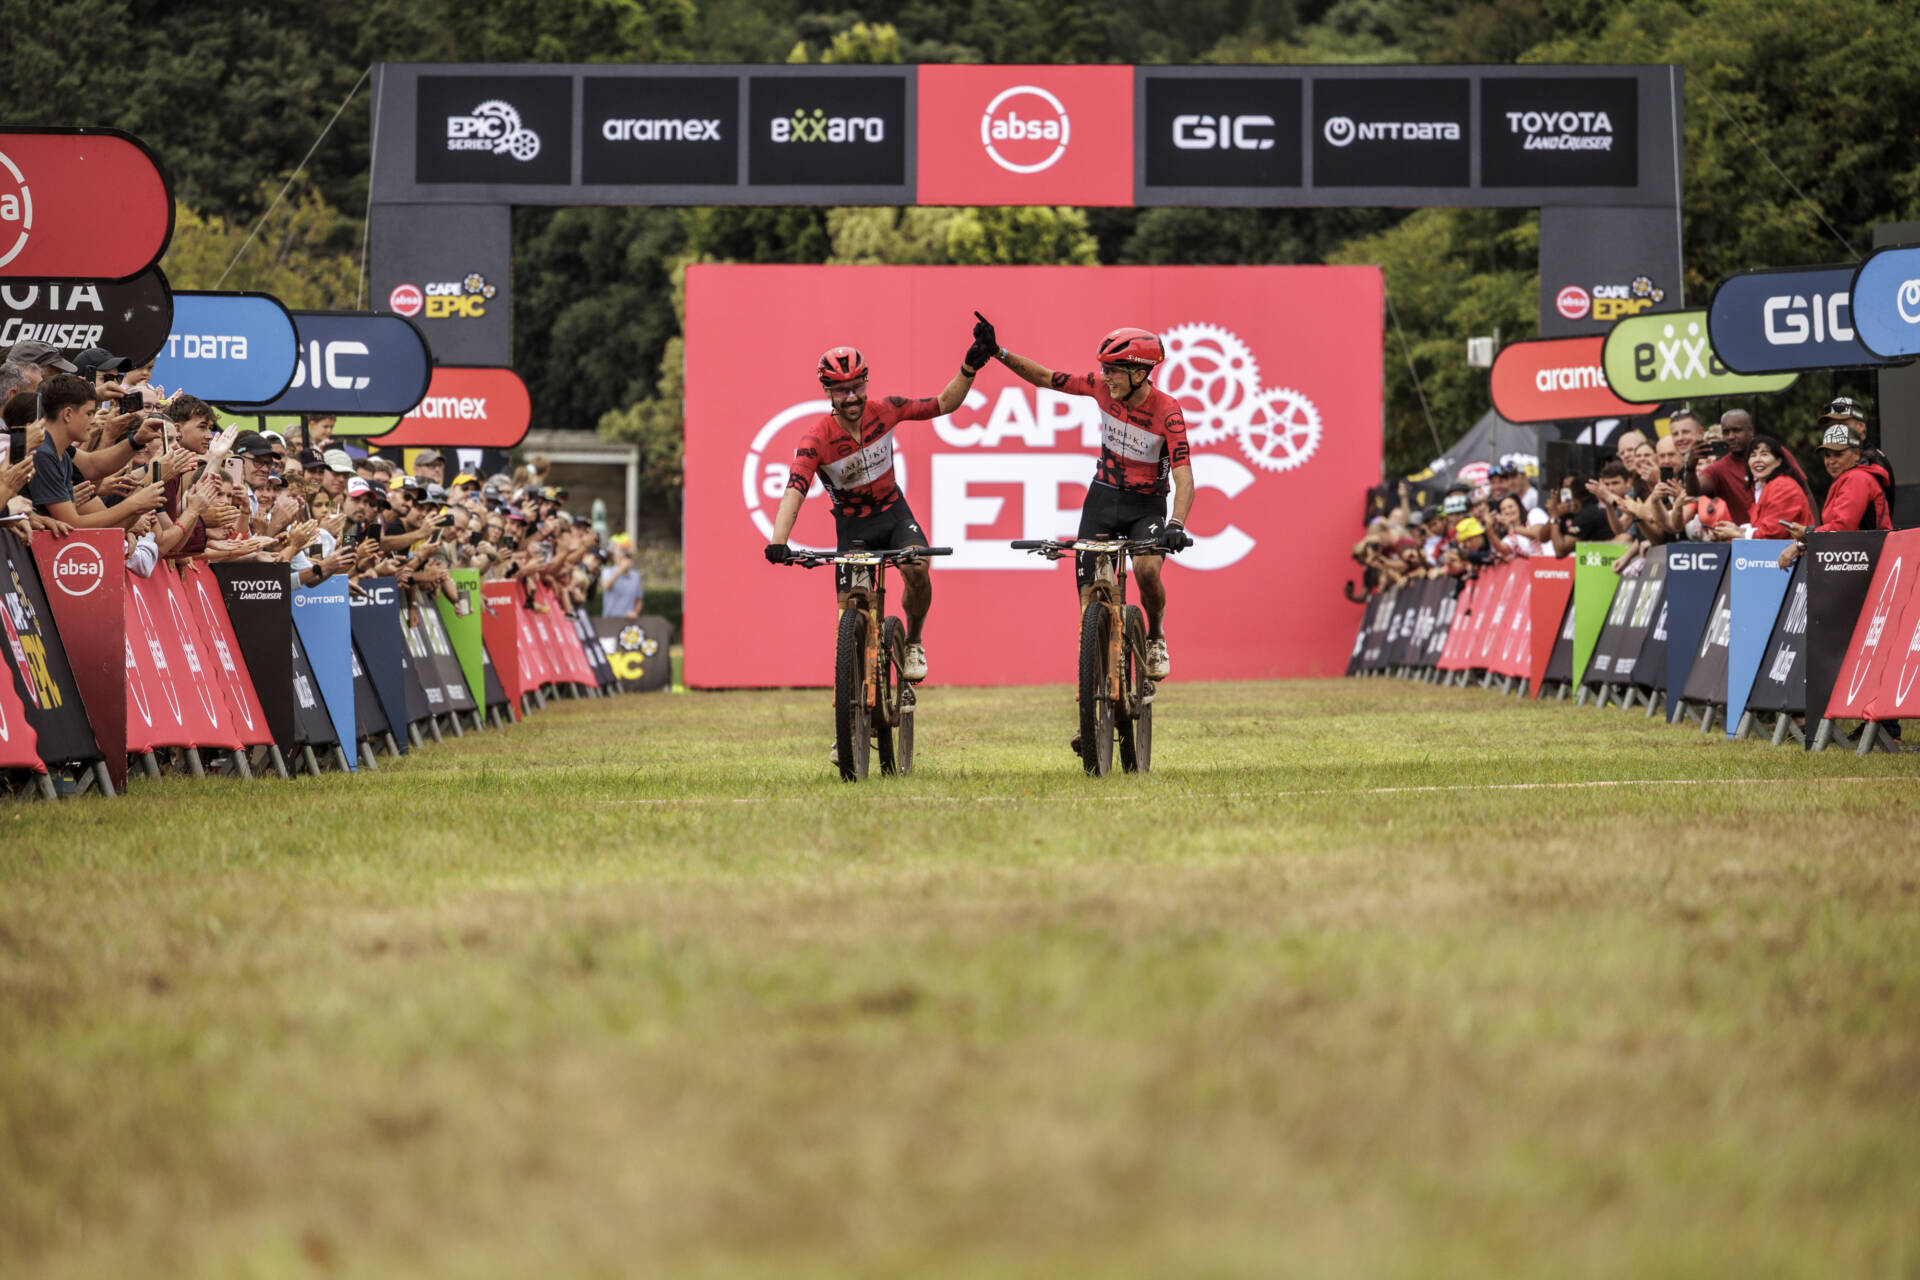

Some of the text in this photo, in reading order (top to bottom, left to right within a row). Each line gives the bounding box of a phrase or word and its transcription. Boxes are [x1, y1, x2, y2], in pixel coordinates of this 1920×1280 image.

[447, 116, 502, 138] EPIC
[602, 119, 721, 141] aramex
[770, 108, 884, 143] exxaro
[991, 114, 1061, 141] absa
[1172, 115, 1275, 150] GIC
[1505, 111, 1613, 133] TOYOTA
[447, 138, 494, 151] SERIES
[425, 282, 462, 296] CAPE
[1592, 285, 1630, 299] CAPE
[425, 294, 486, 318] EPIC
[1763, 292, 1856, 346] GIC
[1634, 322, 1729, 383] exx
[1535, 365, 1608, 393] aram
[404, 396, 488, 420] amex
[58, 557, 99, 576] absa
[1579, 550, 1615, 567] exxar
[1669, 553, 1719, 571] GIC
[1815, 551, 1869, 563] TOYOTA
[230, 580, 282, 592] TOYOTA
